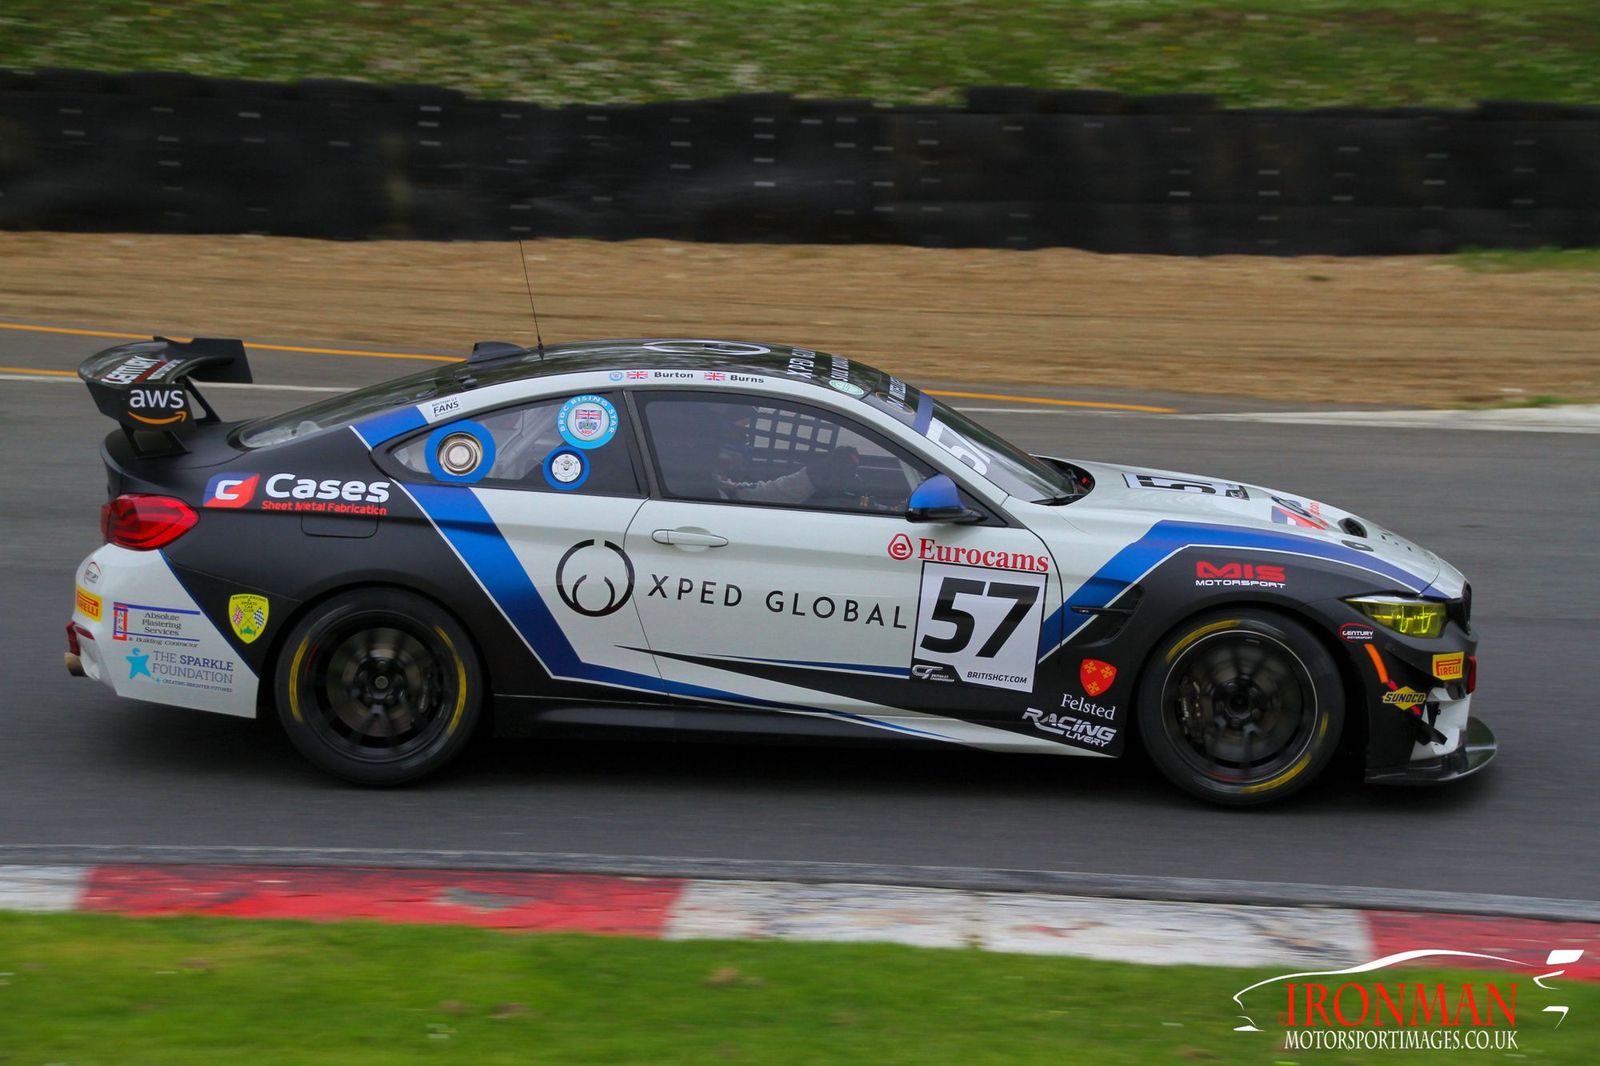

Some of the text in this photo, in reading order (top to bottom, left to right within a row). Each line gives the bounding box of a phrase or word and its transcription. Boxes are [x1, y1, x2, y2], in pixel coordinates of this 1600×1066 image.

[654, 371, 694, 379] Burton
[730, 374, 765, 384] Burns
[129, 389, 185, 409] aws
[433, 400, 460, 414] FANS
[571, 395, 608, 407] RISING
[608, 408, 618, 434] STAR
[265, 473, 391, 504] Cases
[261, 500, 388, 516] Sheet Metal Fabrication
[918, 537, 1049, 573] Eurocams
[1196, 560, 1287, 582] MIS
[1195, 580, 1286, 589] MOTORSPORT
[648, 573, 908, 630] XPED GLOBAL
[144, 611, 179, 621] Absolute
[919, 576, 1041, 659] 57
[142, 619, 181, 630] Plastering
[144, 627, 179, 636] Services
[136, 636, 163, 646] Building
[153, 650, 234, 672] THE SPARKLE
[152, 662, 233, 684] FOUNDATION
[966, 671, 1028, 684] BRITISHGT.COM
[1384, 692, 1425, 704] SUNOCO
[1061, 693, 1116, 720] Felsted
[1022, 707, 1117, 742] RACING
[1066, 731, 1109, 747] LIVERY
